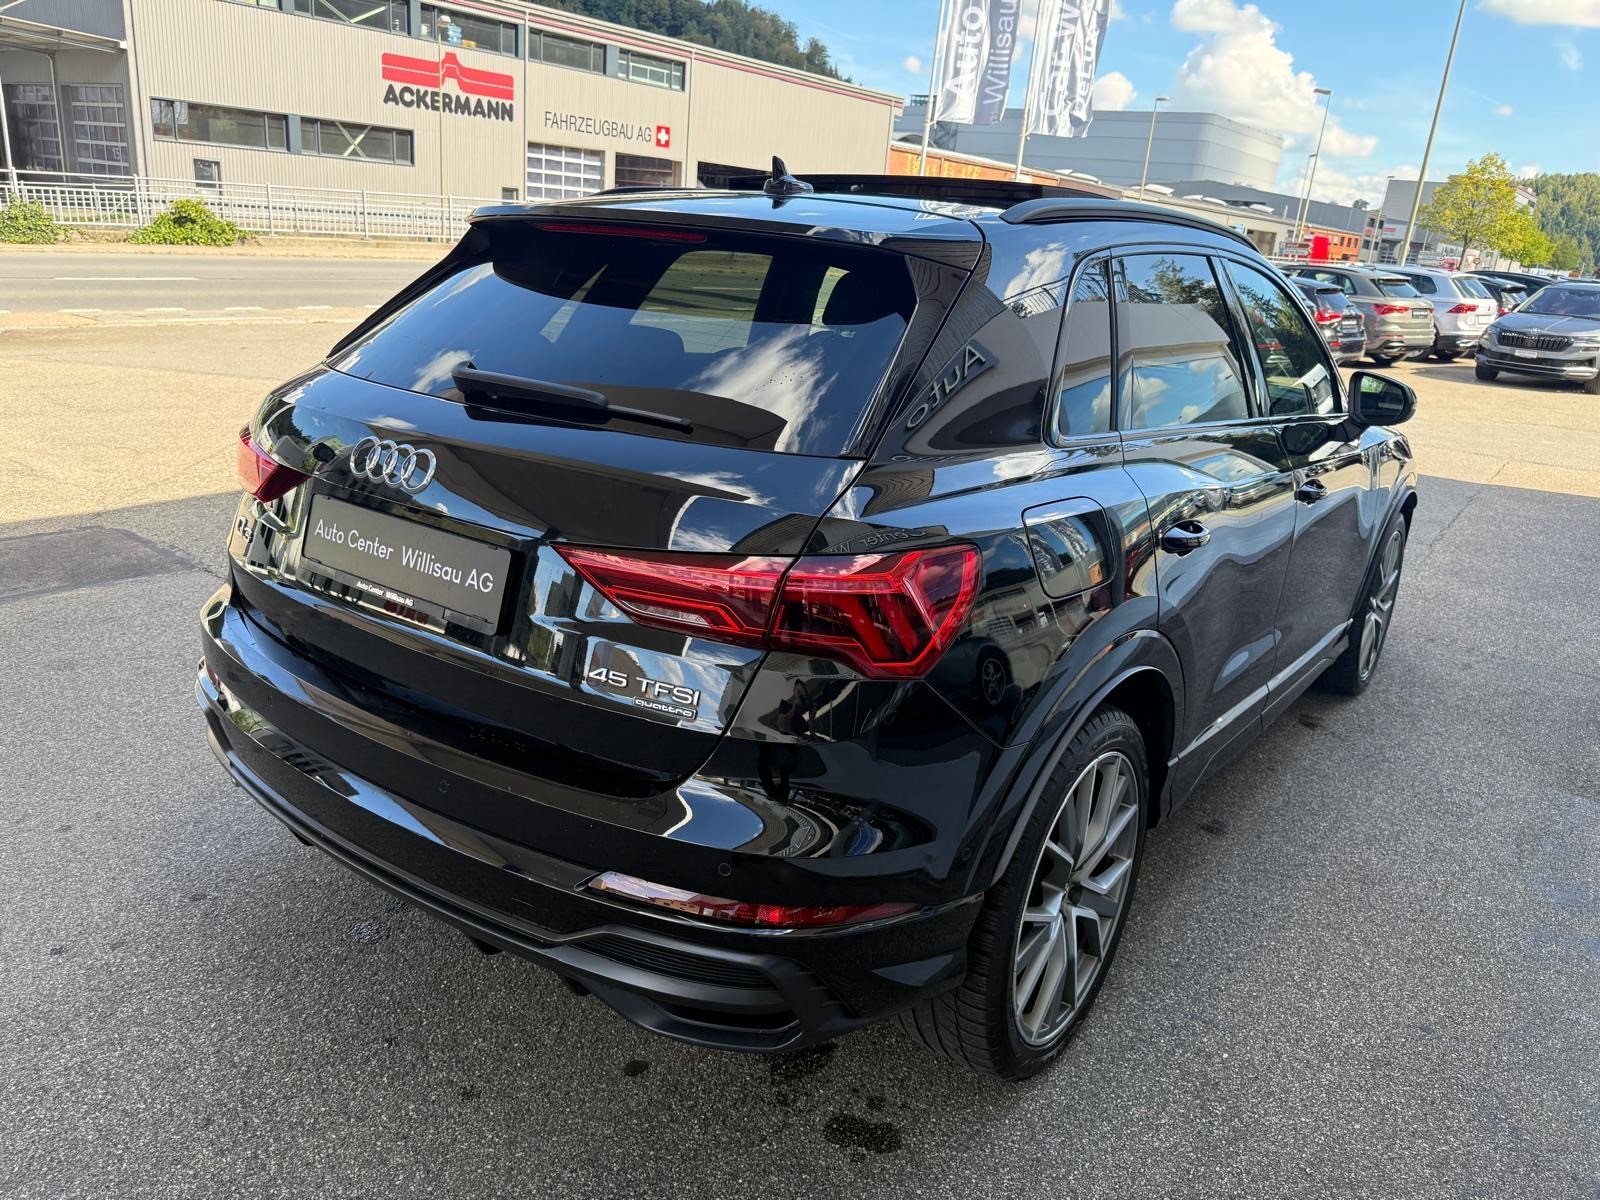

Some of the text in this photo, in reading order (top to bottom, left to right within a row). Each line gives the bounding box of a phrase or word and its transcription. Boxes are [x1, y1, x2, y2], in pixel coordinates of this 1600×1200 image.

[947, 6, 984, 95] Auto
[982, 0, 1018, 105] Willisau
[383, 84, 514, 122] ACKERMANN
[545, 111, 651, 143] FAHRZEUGBAU AG
[314, 519, 494, 593] Auto Center Willisau AG
[356, 580, 369, 590] Auto
[368, 585, 384, 596] Center
[404, 597, 414, 607] AG
[588, 667, 700, 706] 45 TFSI
[635, 699, 693, 717] quattro
